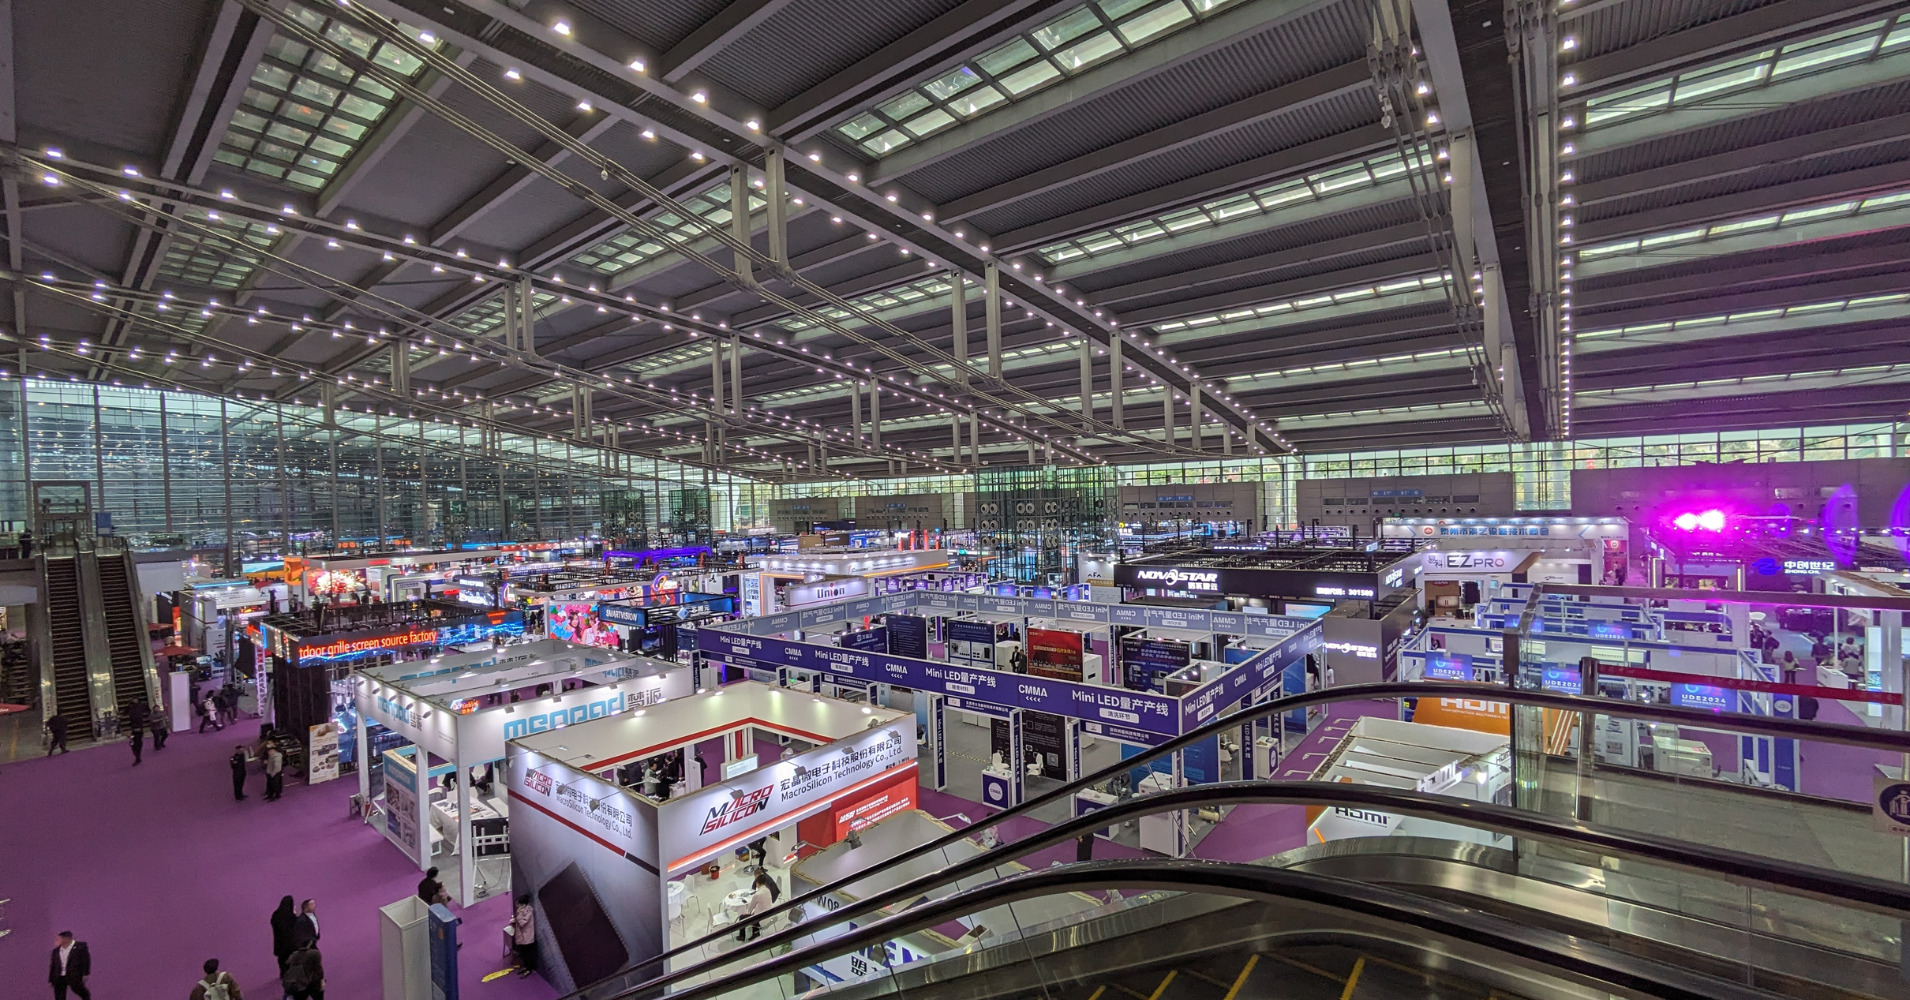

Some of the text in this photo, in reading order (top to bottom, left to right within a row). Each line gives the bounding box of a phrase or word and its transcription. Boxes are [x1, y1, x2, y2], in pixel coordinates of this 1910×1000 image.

[1447, 554, 1504, 568] EZPRO
[1784, 560, 1835, 571] 中创世纪
[1138, 569, 1218, 585] NOVASTAR
[817, 583, 845, 598] Union
[605, 609, 638, 621] SMARTVISION
[328, 641, 349, 658] grille
[352, 640, 380, 652] screen
[382, 634, 408, 647] source
[410, 631, 437, 644] factory
[815, 650, 869, 667] Mini LED量产产线
[885, 663, 908, 675] CMMA
[1433, 668, 1465, 676] UDE2024
[925, 667, 997, 688] Mini LED量产产线
[1018, 684, 1048, 697] CMMA
[1072, 689, 1169, 716] Mini LED量产产线
[1681, 693, 1726, 704] UDE2024
[1184, 700, 1196, 716] Mini
[780, 735, 902, 791] 宏晶微电子科技股份有限公司
[781, 776, 833, 802] MacroSilicon
[834, 758, 875, 780] Technology
